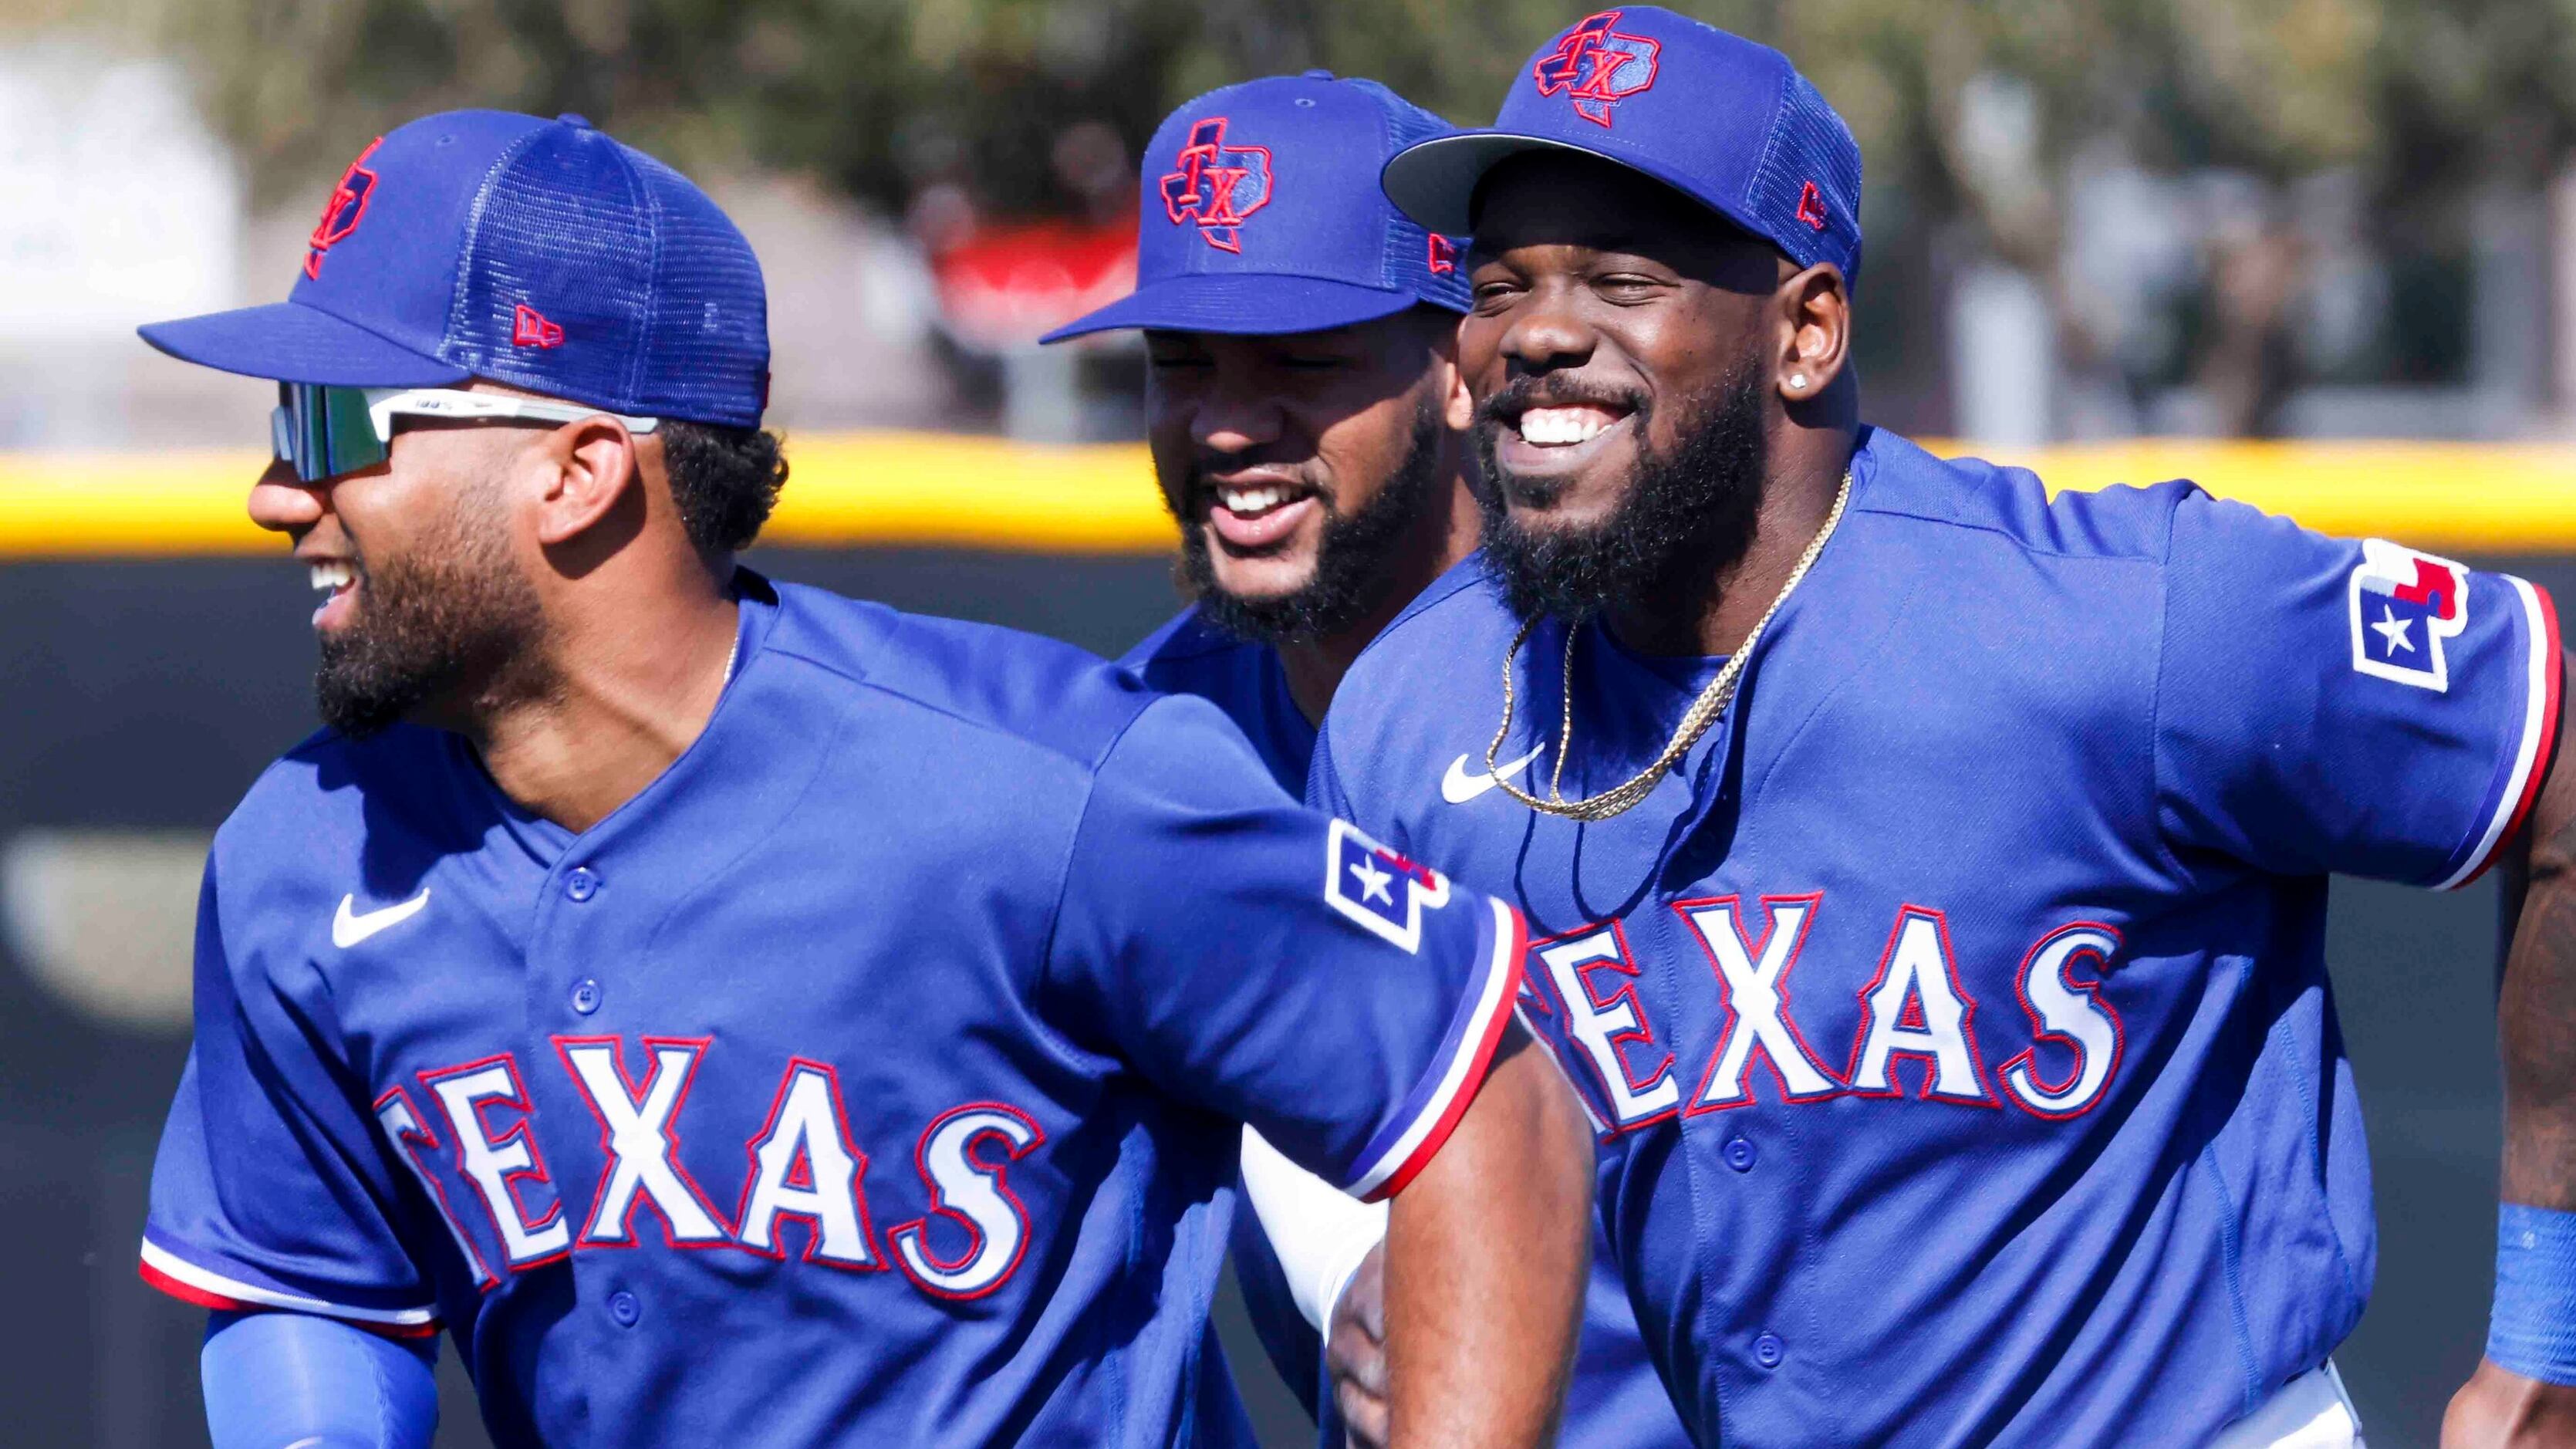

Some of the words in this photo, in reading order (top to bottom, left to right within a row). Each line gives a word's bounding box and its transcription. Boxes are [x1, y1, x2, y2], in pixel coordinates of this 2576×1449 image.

[1558, 29, 1636, 103] TX
[1177, 144, 1250, 226] TX
[1513, 890, 2125, 1146] EXAS
